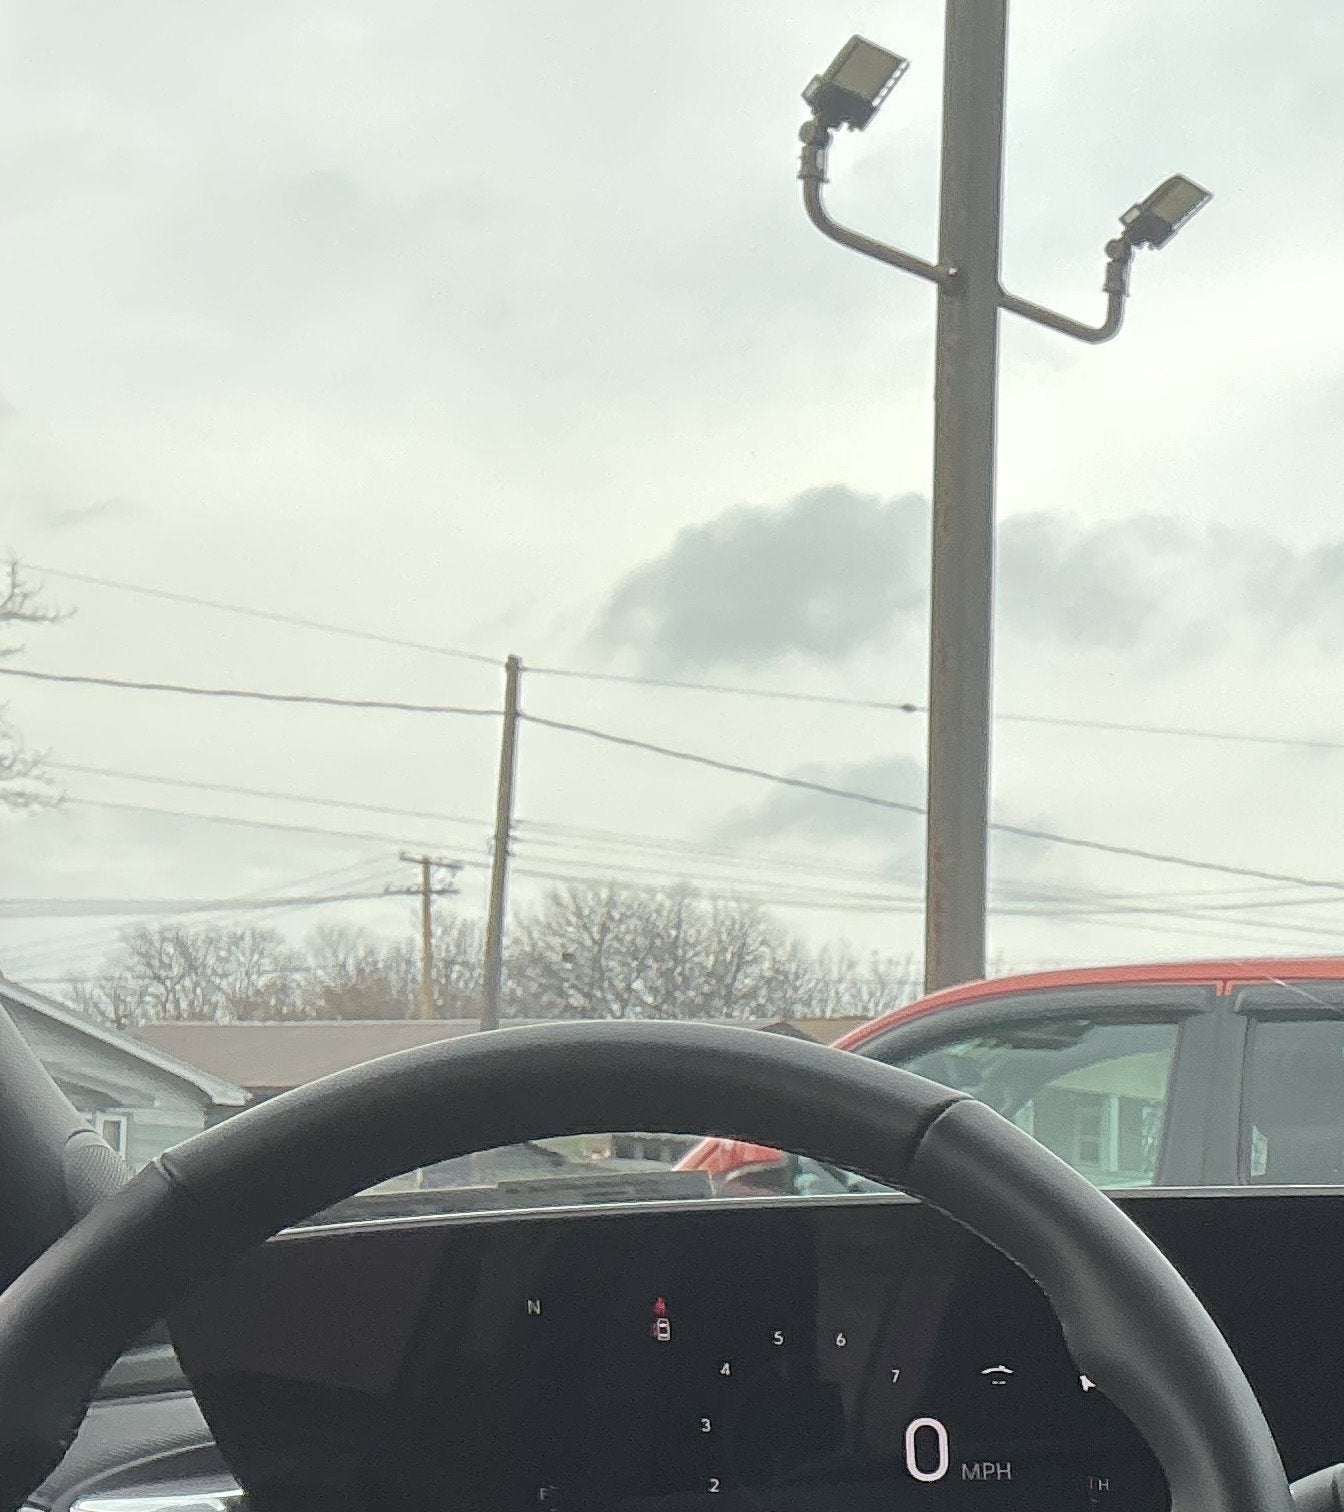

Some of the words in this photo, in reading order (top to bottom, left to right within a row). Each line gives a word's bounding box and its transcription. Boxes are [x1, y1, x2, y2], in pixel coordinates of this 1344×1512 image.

[773, 1330, 785, 1346] 5
[834, 1332, 847, 1347] 6
[890, 1368, 901, 1384] 7
[700, 1417, 712, 1433] 3
[904, 1416, 950, 1484] 0
[960, 1462, 1013, 1482] MPH
[707, 1477, 720, 1494] 2
